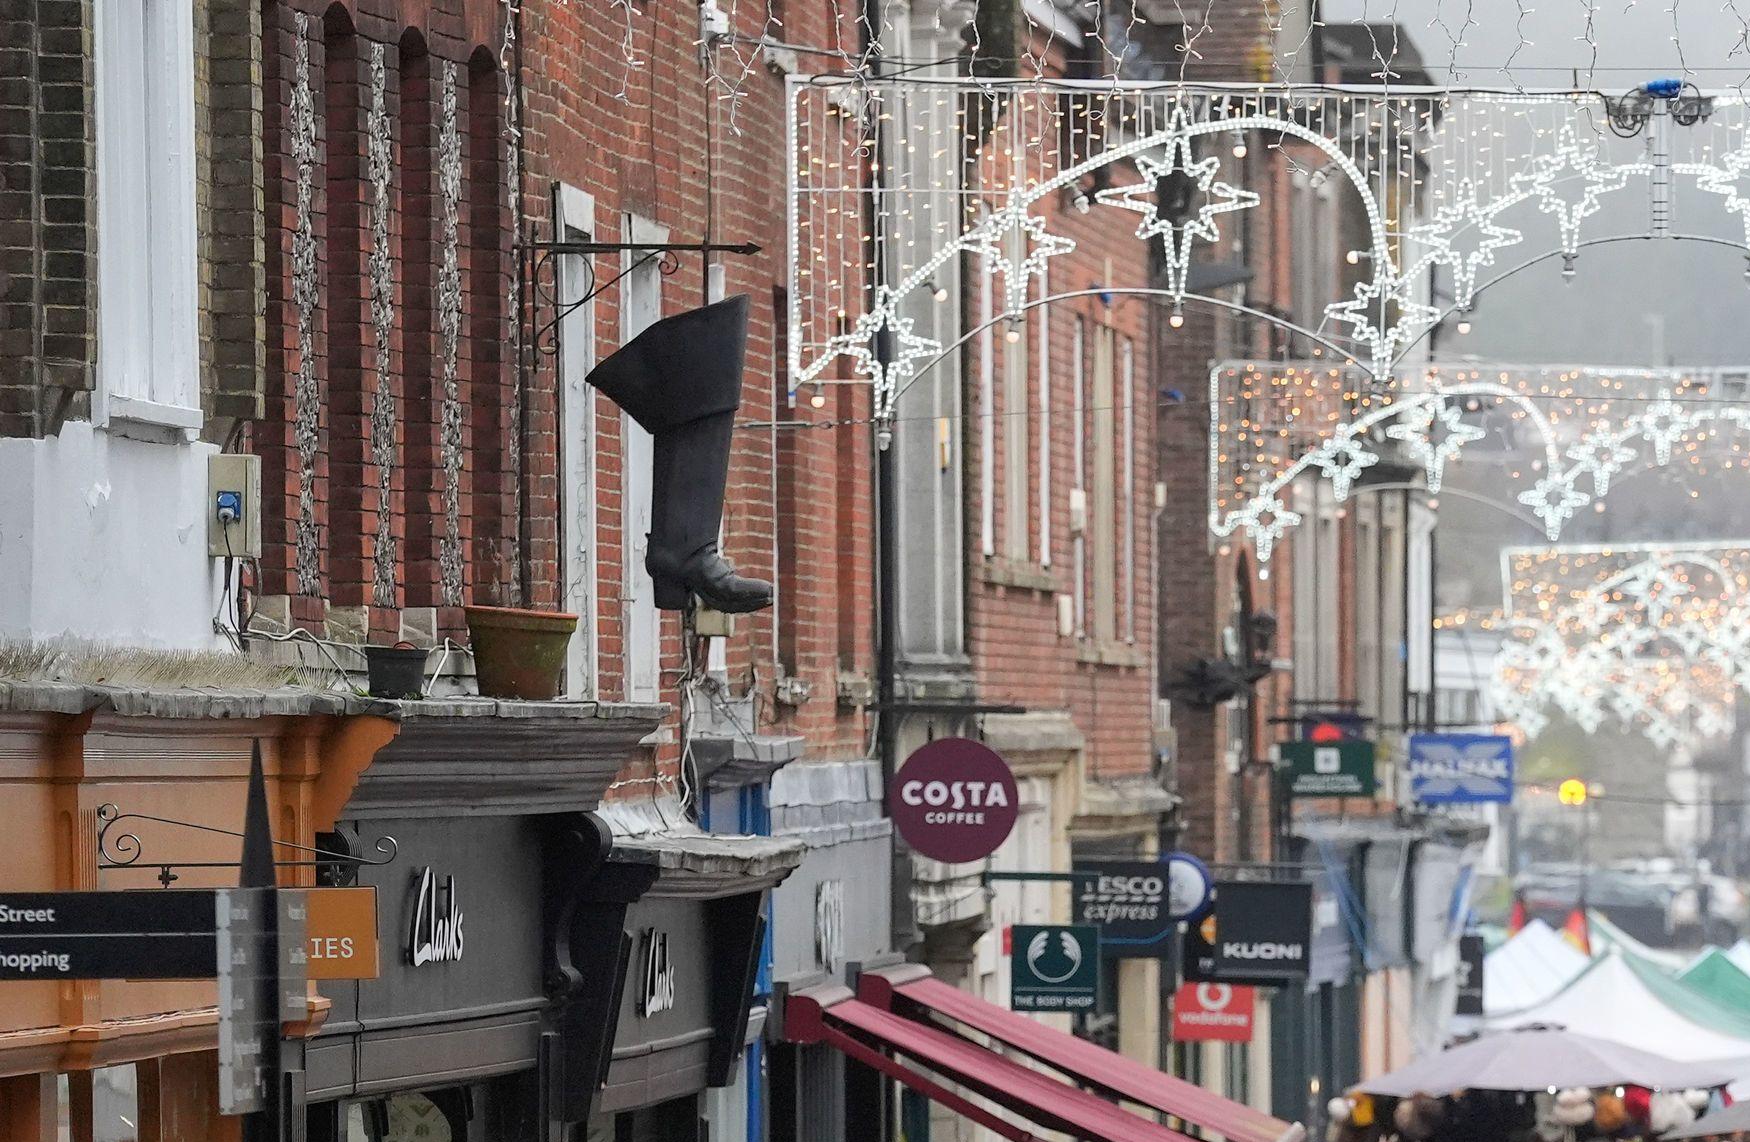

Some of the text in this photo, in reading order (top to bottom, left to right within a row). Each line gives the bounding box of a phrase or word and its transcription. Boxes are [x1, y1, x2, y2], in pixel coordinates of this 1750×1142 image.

[901, 779, 1009, 811] COSTA
[925, 812, 986, 825] COFFEE
[0, 904, 56, 922] Street
[413, 865, 464, 967] Clarks
[1083, 902, 1159, 924] express
[1223, 942, 1303, 960] KUONI
[646, 927, 675, 1018] Clarks
